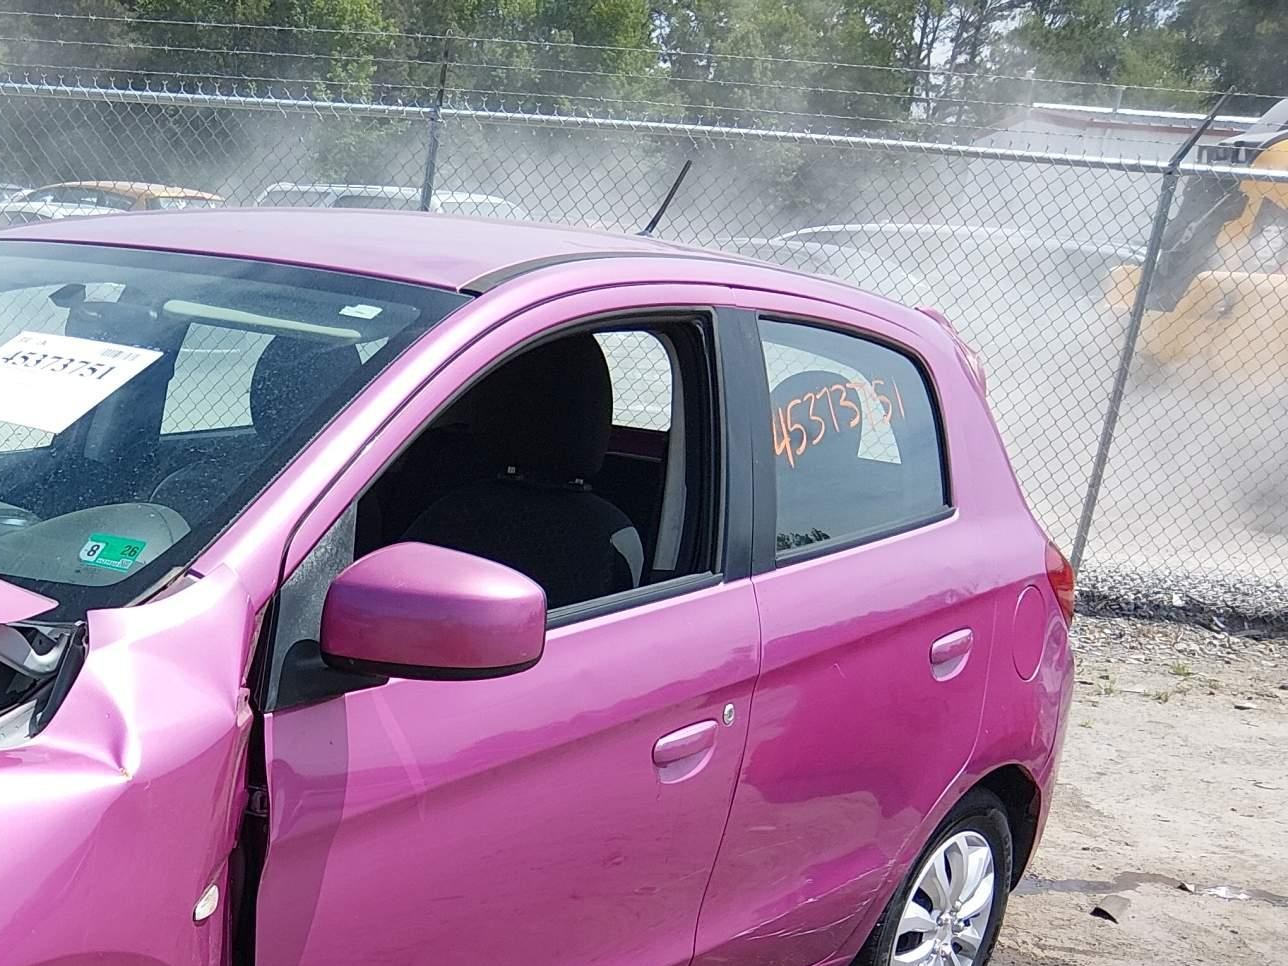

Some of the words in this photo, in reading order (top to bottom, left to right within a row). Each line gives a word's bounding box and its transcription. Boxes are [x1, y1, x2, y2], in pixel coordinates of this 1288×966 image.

[0, 350, 118, 380] 45373751
[772, 376, 905, 469] 45373751
[86, 543, 101, 558] 8
[120, 544, 140, 558] 26
